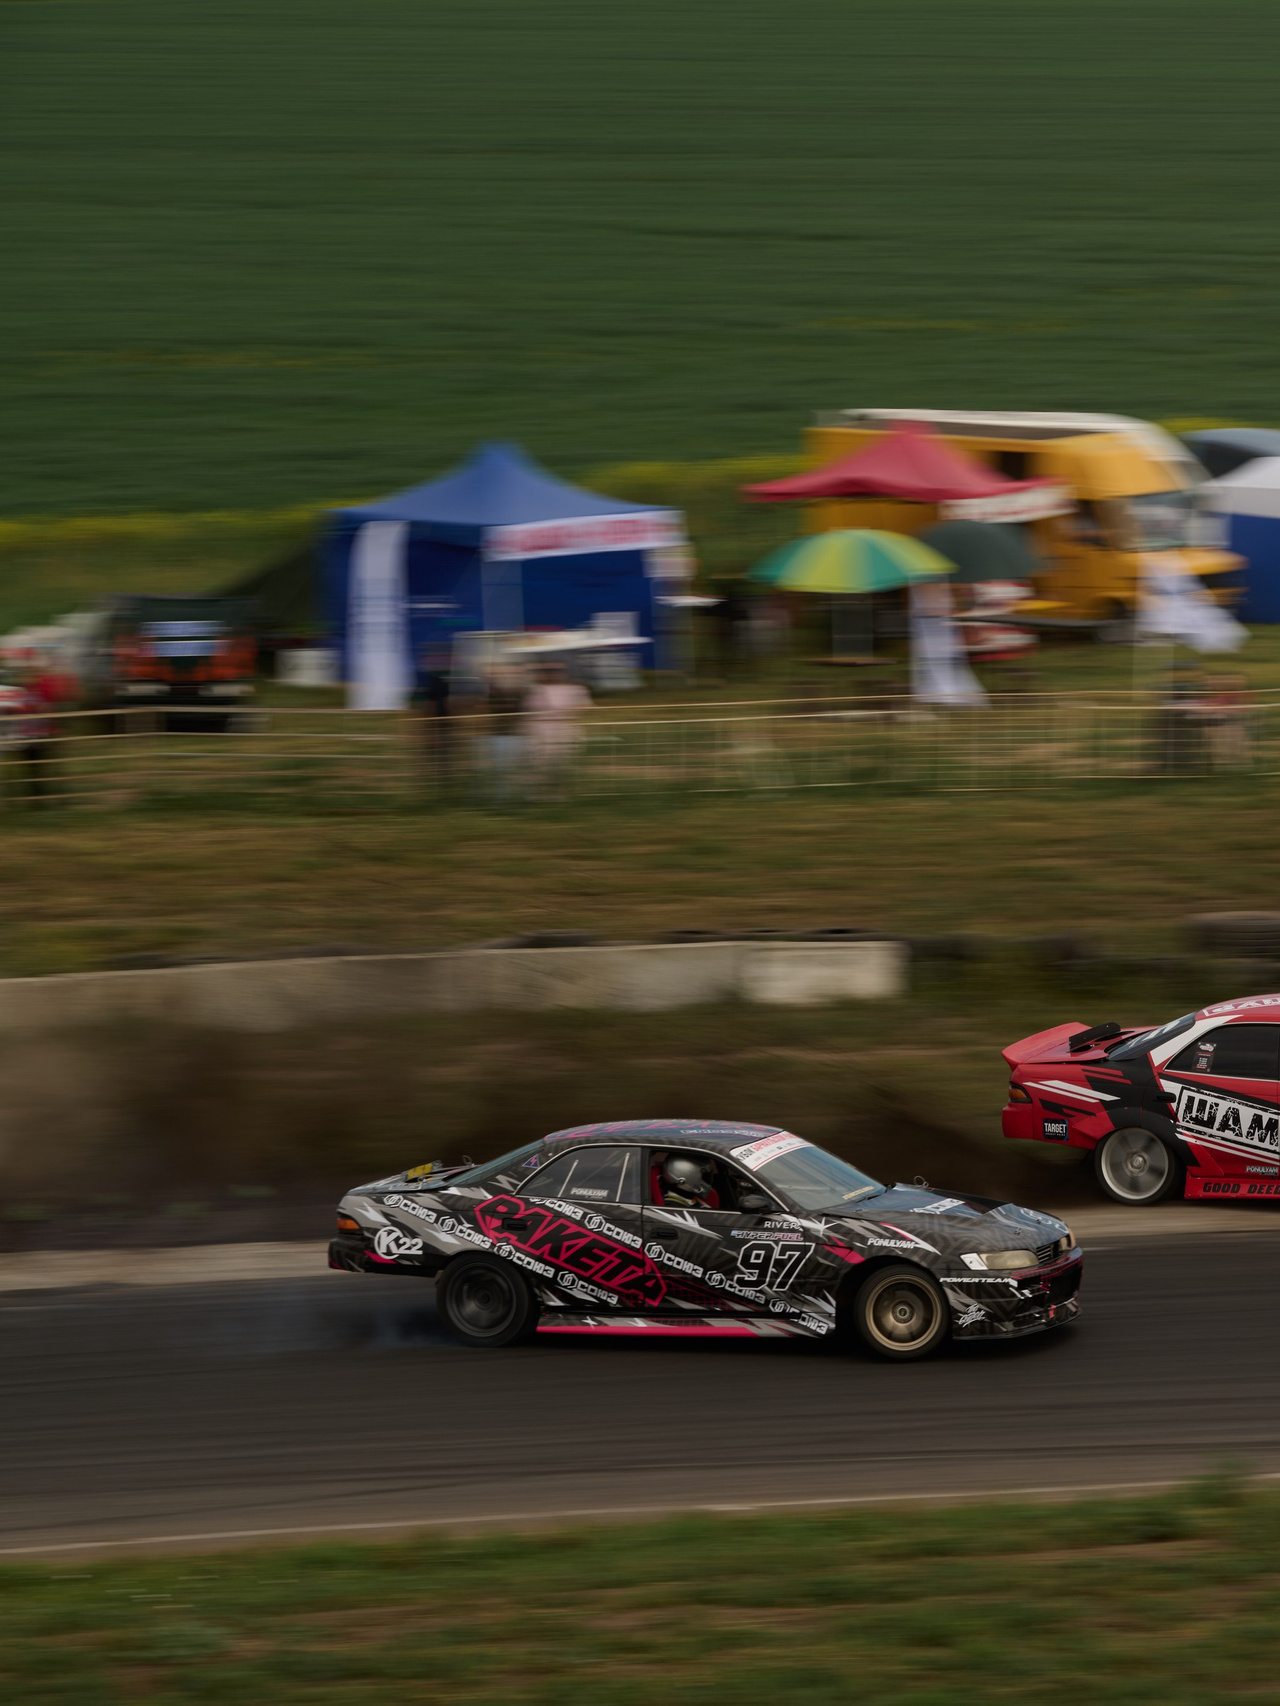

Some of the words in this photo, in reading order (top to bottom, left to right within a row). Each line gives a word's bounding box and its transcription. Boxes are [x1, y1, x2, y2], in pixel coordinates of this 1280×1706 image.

[1044, 1122, 1067, 1133] TARGET
[400, 1200, 438, 1224] СОЮЗ
[455, 1225, 493, 1250] СОЮЗ
[512, 1252, 555, 1279] СОЮЗ
[576, 1280, 619, 1305] СОЮЗ
[602, 1222, 643, 1249] СОЮЗ
[663, 1252, 704, 1278] СОЮЗ
[733, 1241, 816, 1291] 97
[867, 1238, 915, 1249] PONULYAM
